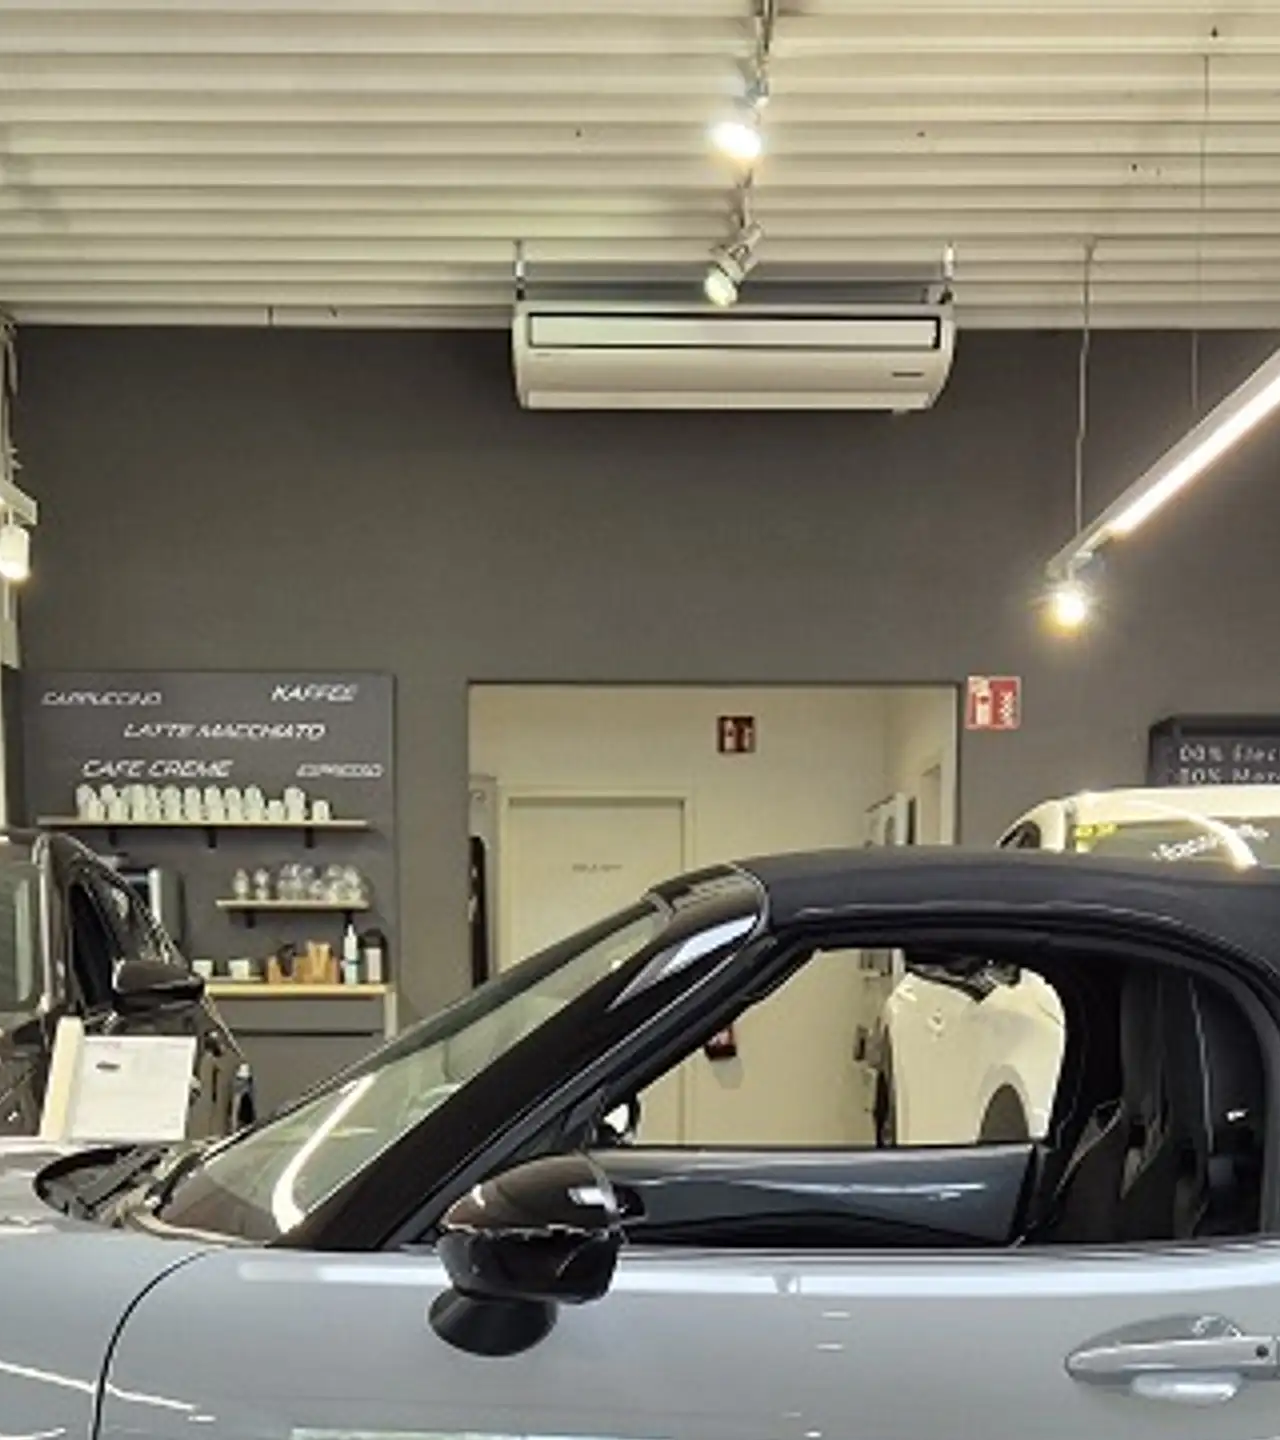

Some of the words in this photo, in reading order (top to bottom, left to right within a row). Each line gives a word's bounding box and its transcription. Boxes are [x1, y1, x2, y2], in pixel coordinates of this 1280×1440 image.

[40, 691, 162, 706] CAPPUCCINO
[271, 683, 359, 702] KAFFEE
[124, 723, 195, 739] LATTE
[196, 722, 327, 740] MACCHIATO
[81, 759, 144, 778] CAFE
